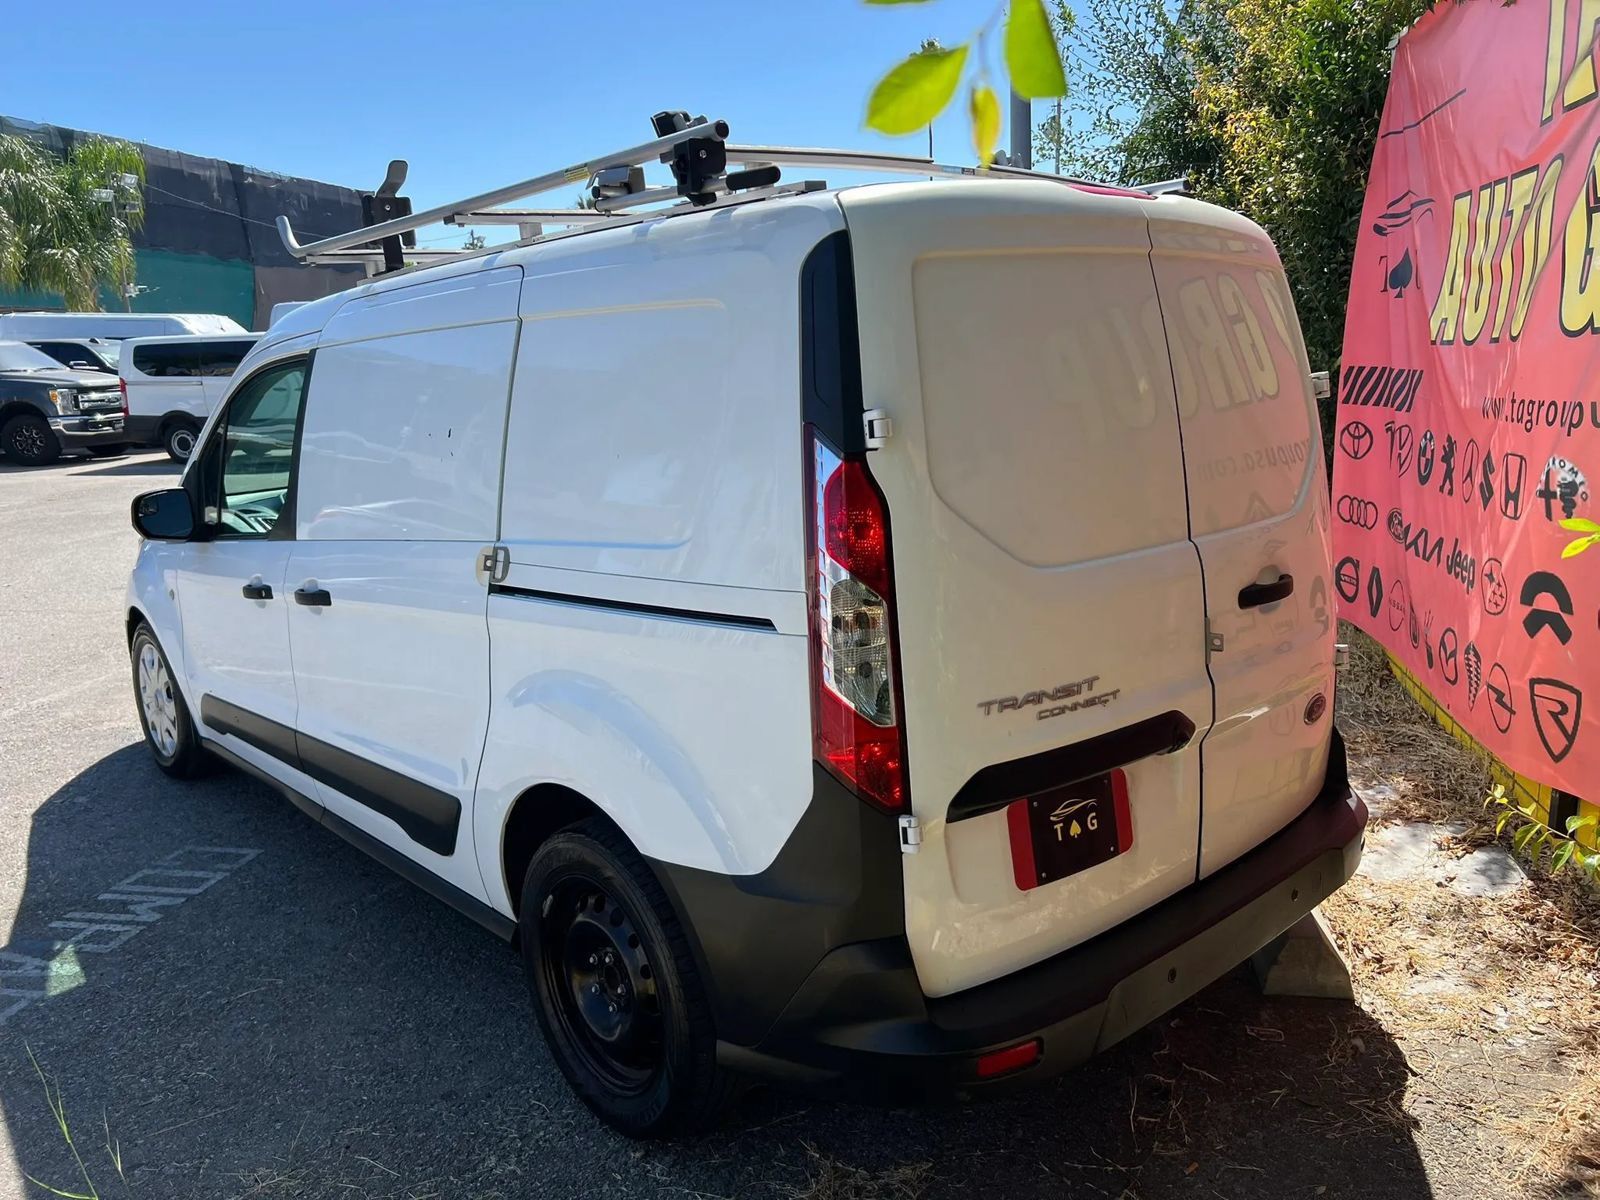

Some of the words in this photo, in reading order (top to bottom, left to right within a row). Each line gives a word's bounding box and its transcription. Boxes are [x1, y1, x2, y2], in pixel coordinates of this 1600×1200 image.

[1429, 152, 1564, 346] AUTO
[1446, 537, 1476, 595] Jeep
[977, 675, 1100, 716] TRANSIT
[1036, 688, 1120, 720] CONNECT
